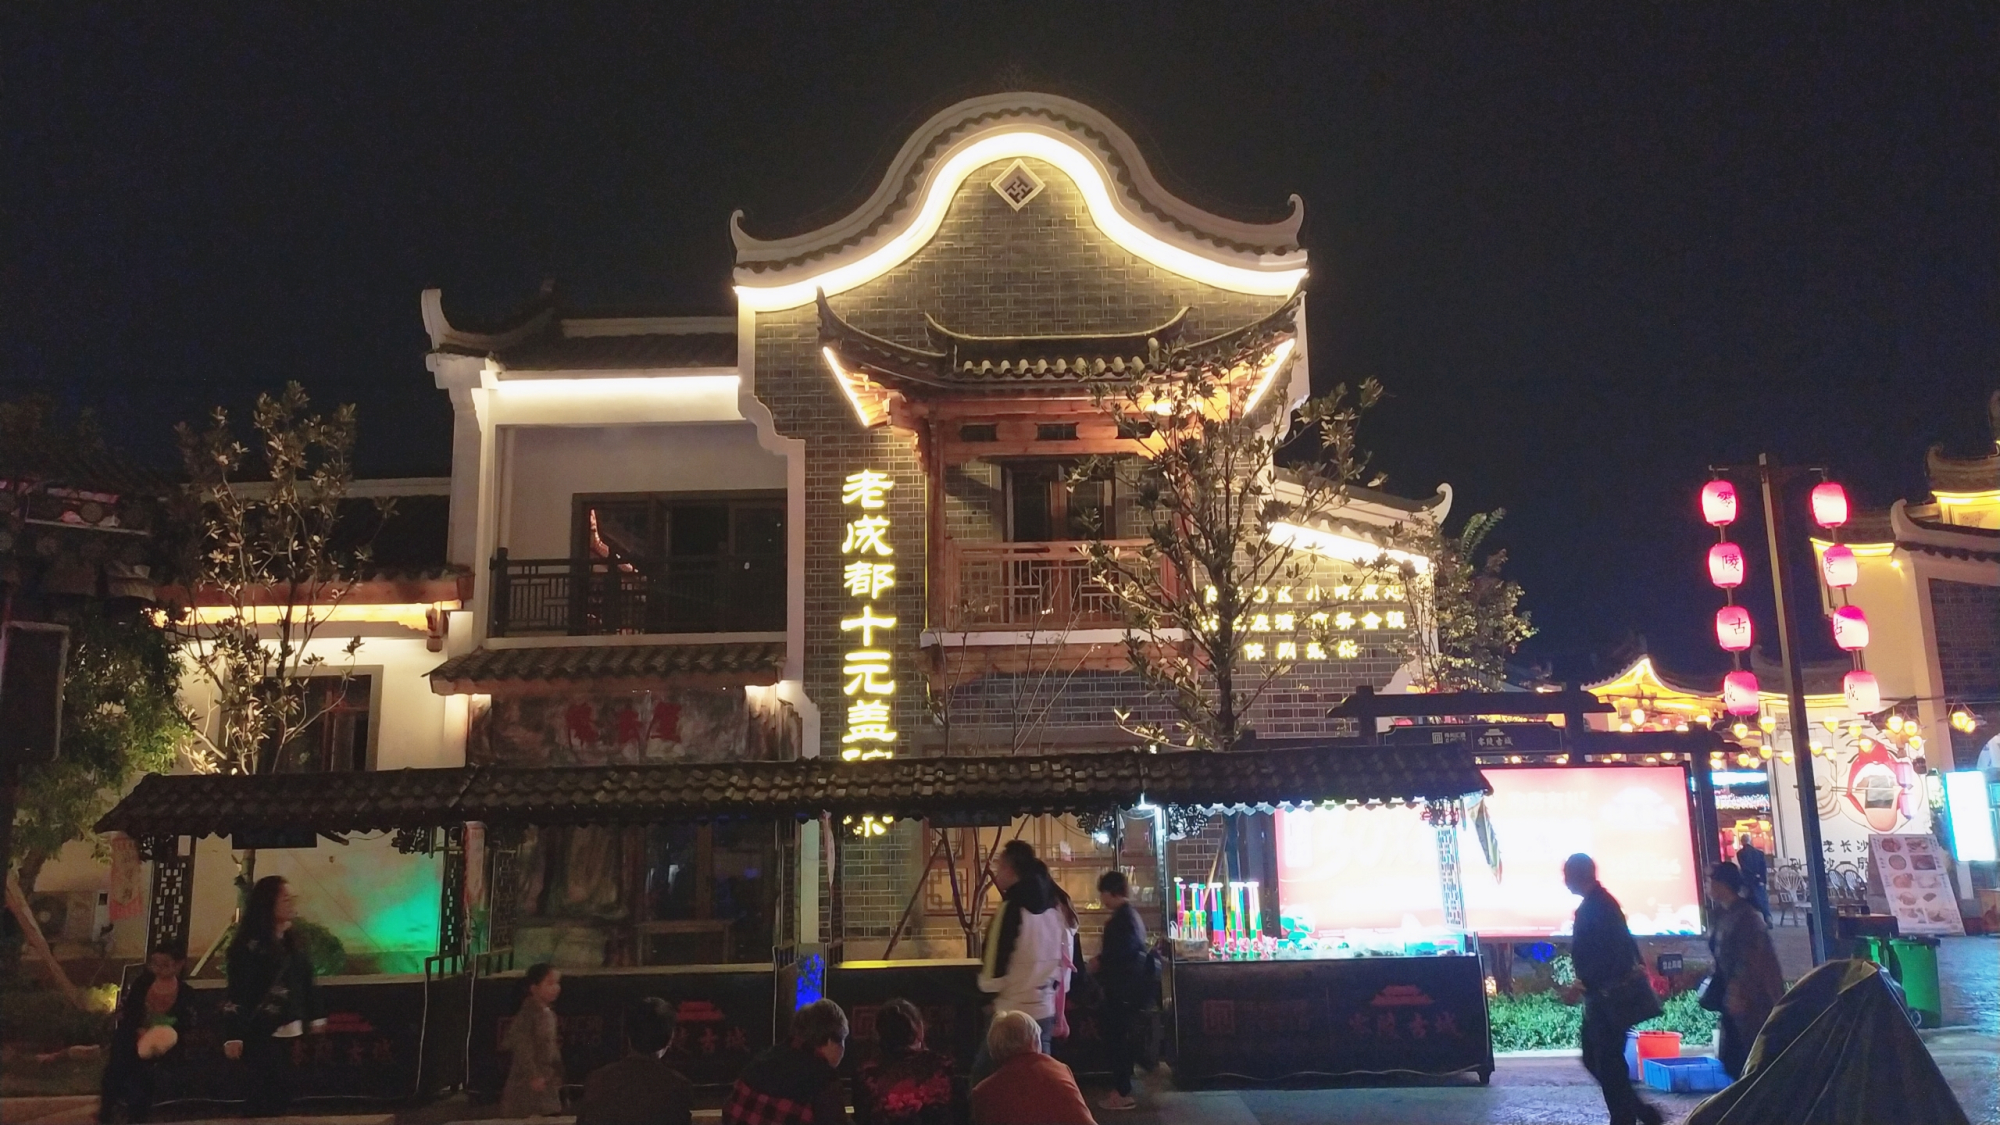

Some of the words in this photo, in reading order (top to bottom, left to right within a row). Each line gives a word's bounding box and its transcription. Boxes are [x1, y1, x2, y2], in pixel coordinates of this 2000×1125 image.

[1722, 554, 1739, 572] 陵
[1730, 617, 1747, 636] 古
[841, 468, 897, 838] 老成都十元盖
[1823, 839, 1869, 853] 老长沙
